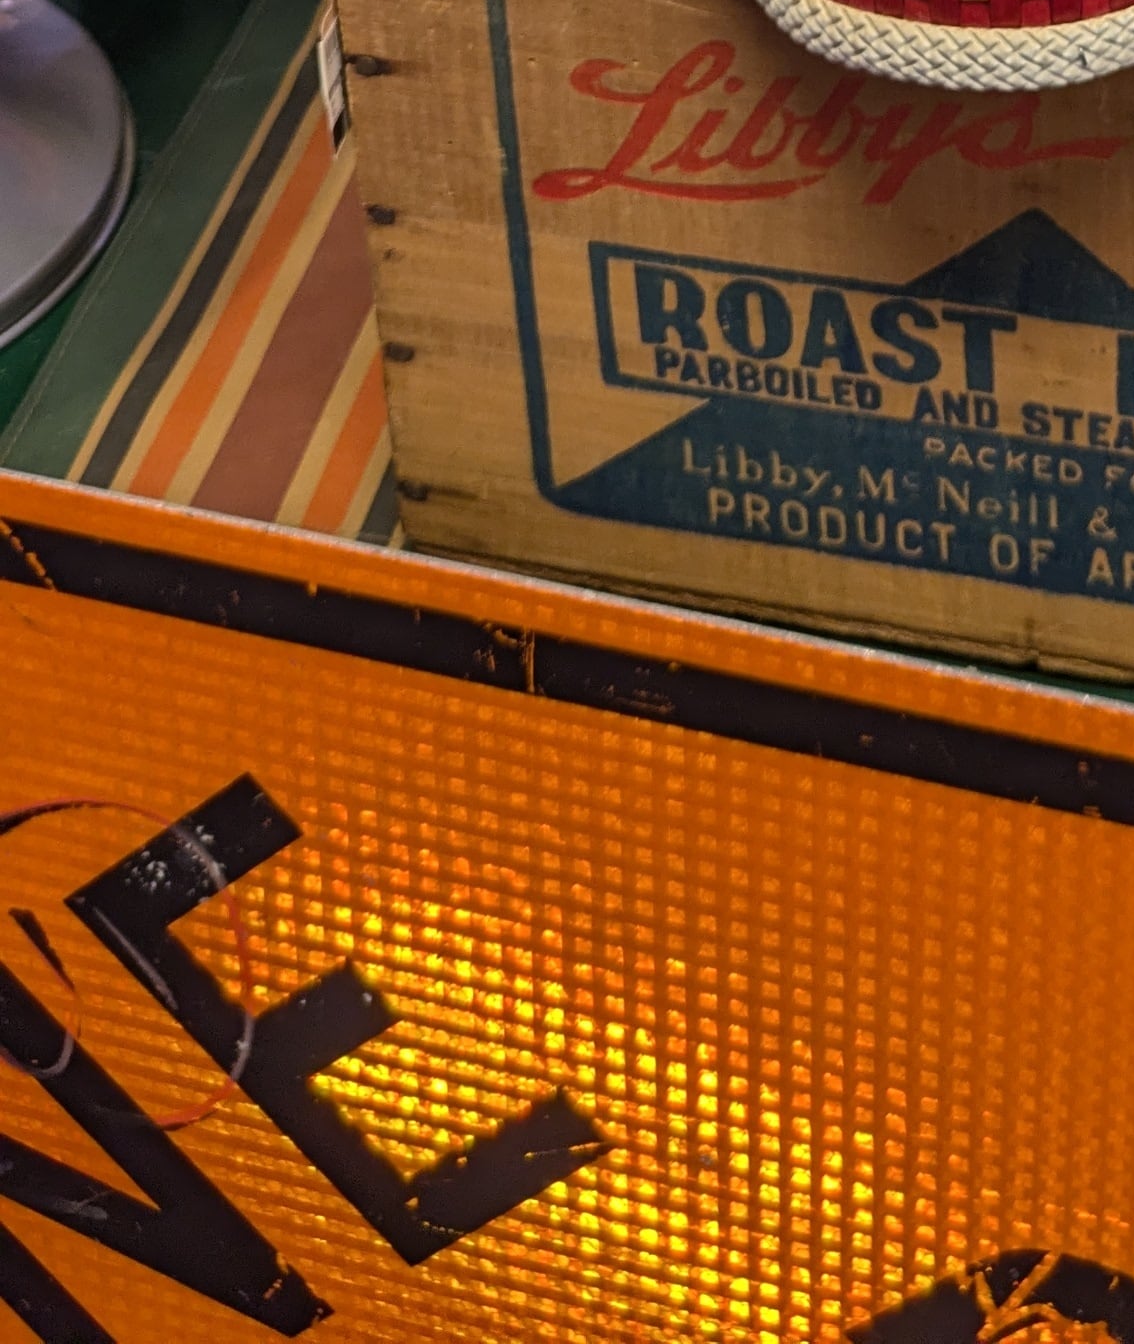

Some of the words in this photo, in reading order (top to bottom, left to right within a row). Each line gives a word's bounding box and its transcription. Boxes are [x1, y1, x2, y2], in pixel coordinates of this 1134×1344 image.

[634, 263, 1017, 394] ROAST
[654, 346, 882, 411] PARBOILED
[912, 386, 1000, 429] AND
[922, 436, 1083, 484] PACKED
[707, 486, 957, 562] PRODUCT
[989, 533, 1056, 576] OF
[937, 476, 1058, 529] Neill
[1087, 506, 1119, 541] &
